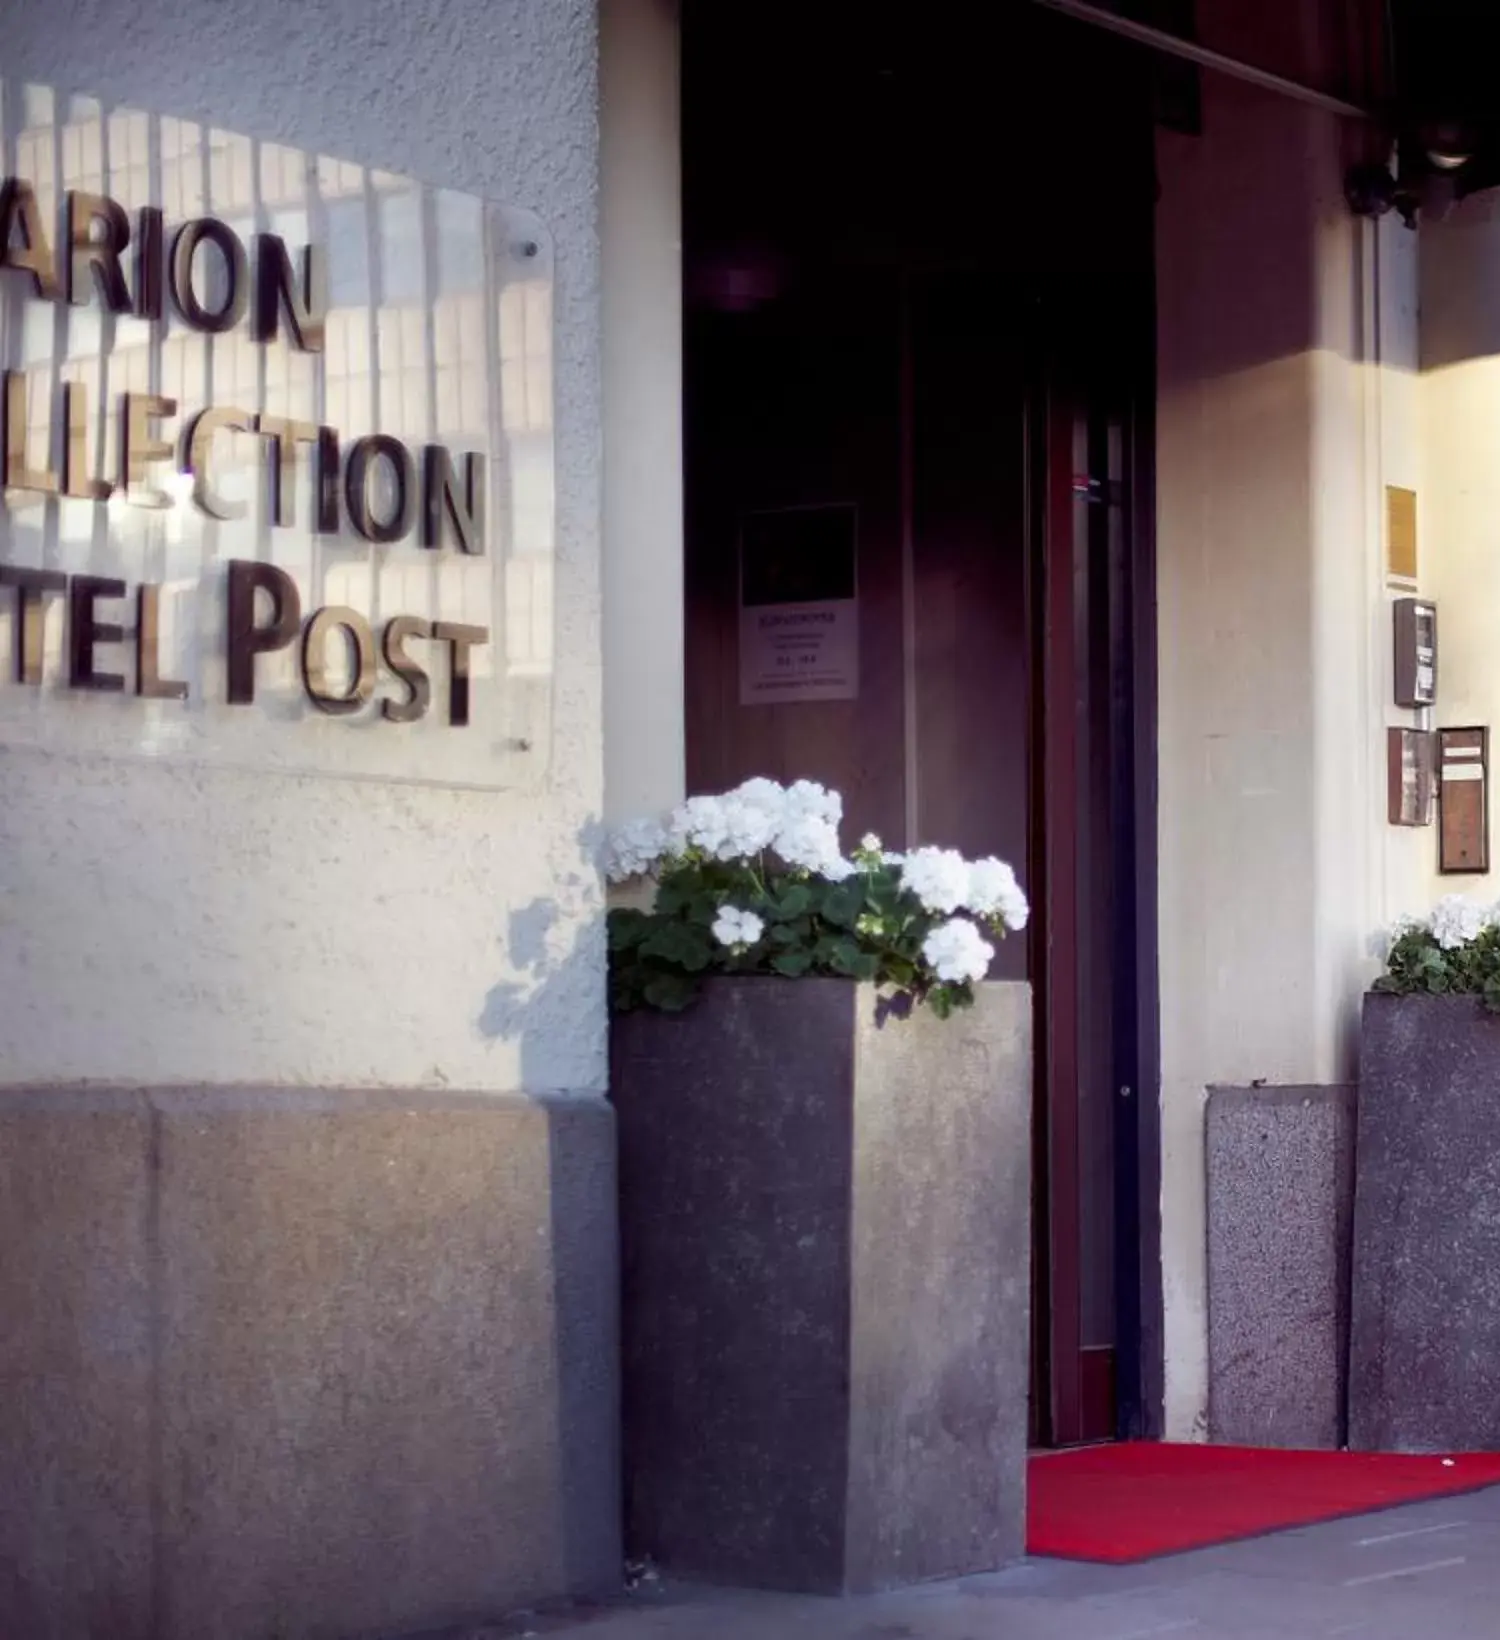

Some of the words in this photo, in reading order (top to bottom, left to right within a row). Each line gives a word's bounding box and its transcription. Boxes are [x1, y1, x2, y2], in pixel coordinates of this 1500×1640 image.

[0, 177, 326, 352] ARION
[2, 369, 487, 555] LLECTION
[0, 564, 190, 701] TEL
